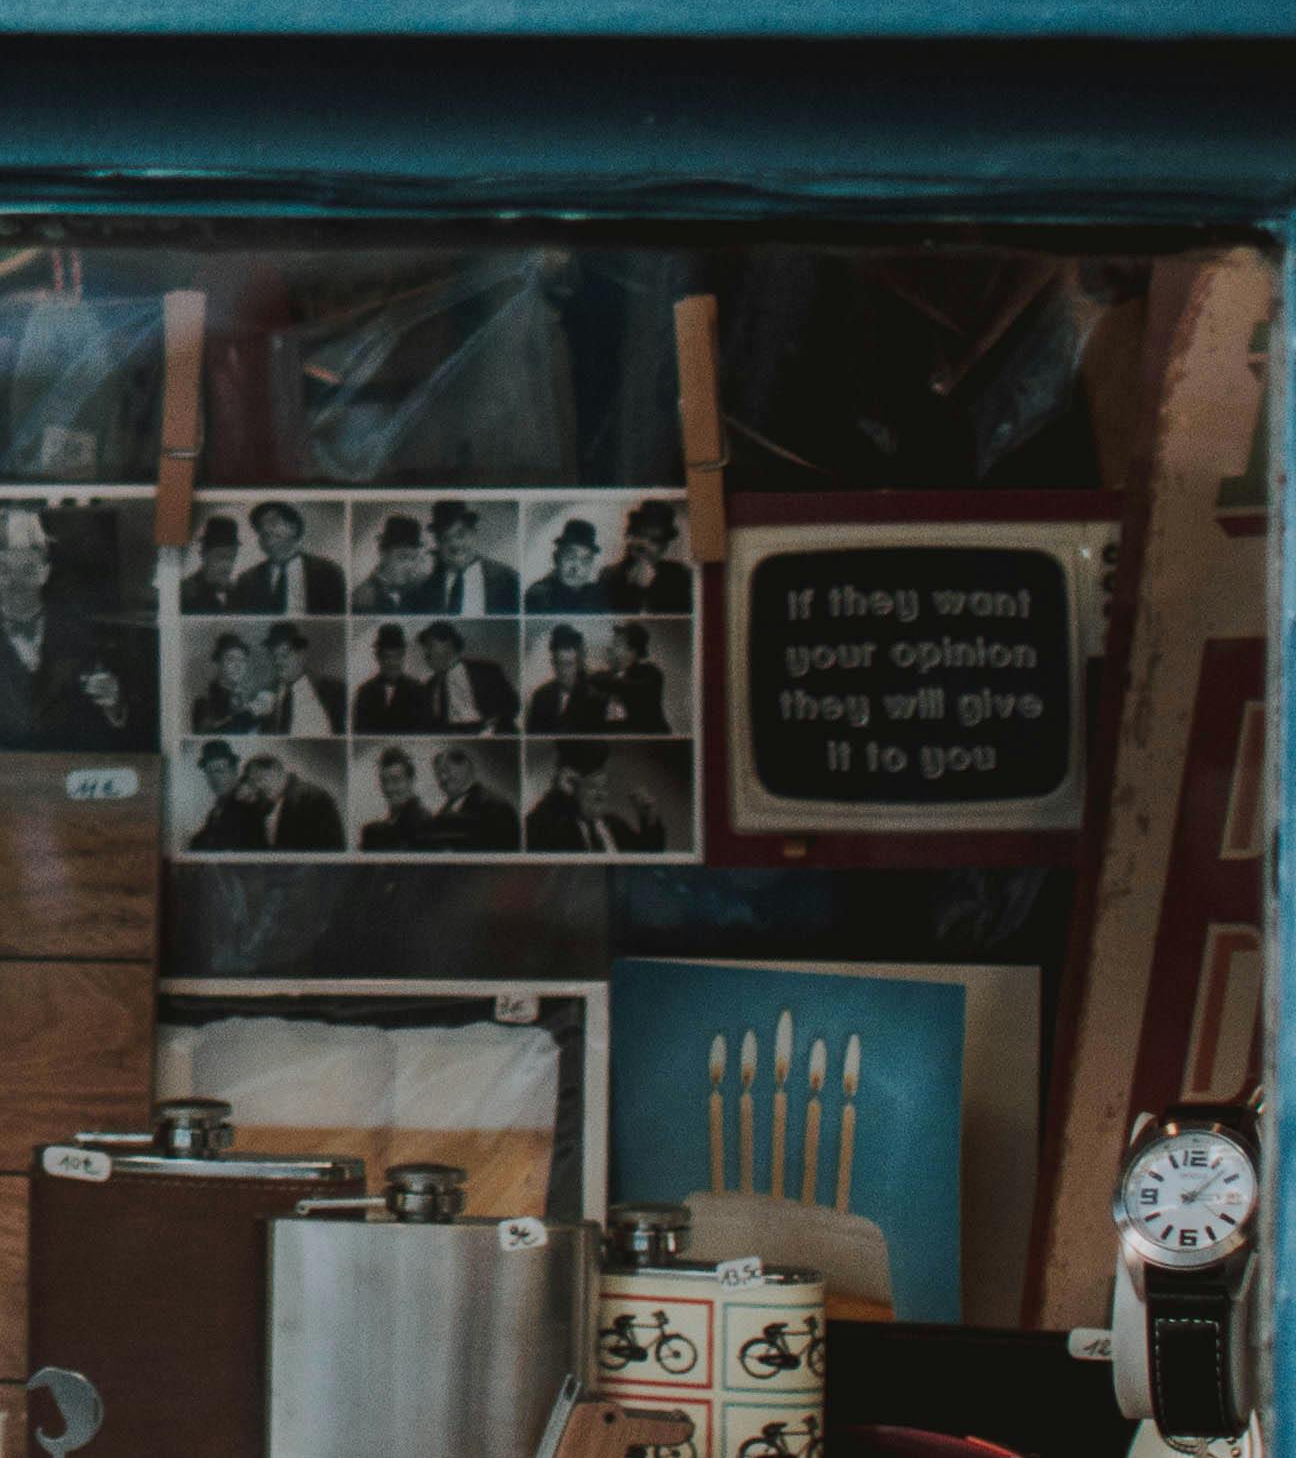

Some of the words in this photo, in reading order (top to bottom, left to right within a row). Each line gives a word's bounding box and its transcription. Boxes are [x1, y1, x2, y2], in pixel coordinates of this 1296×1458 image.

[828, 584, 919, 622] they
[931, 588, 1032, 619] want
[784, 643, 878, 677] your
[888, 636, 1037, 674] opinion
[779, 688, 871, 728] they
[883, 687, 945, 720] will
[957, 687, 1044, 727] give
[827, 740, 851, 772] it
[865, 740, 908, 773] to
[920, 745, 998, 780] you
[1179, 1229, 1197, 1247] 6
